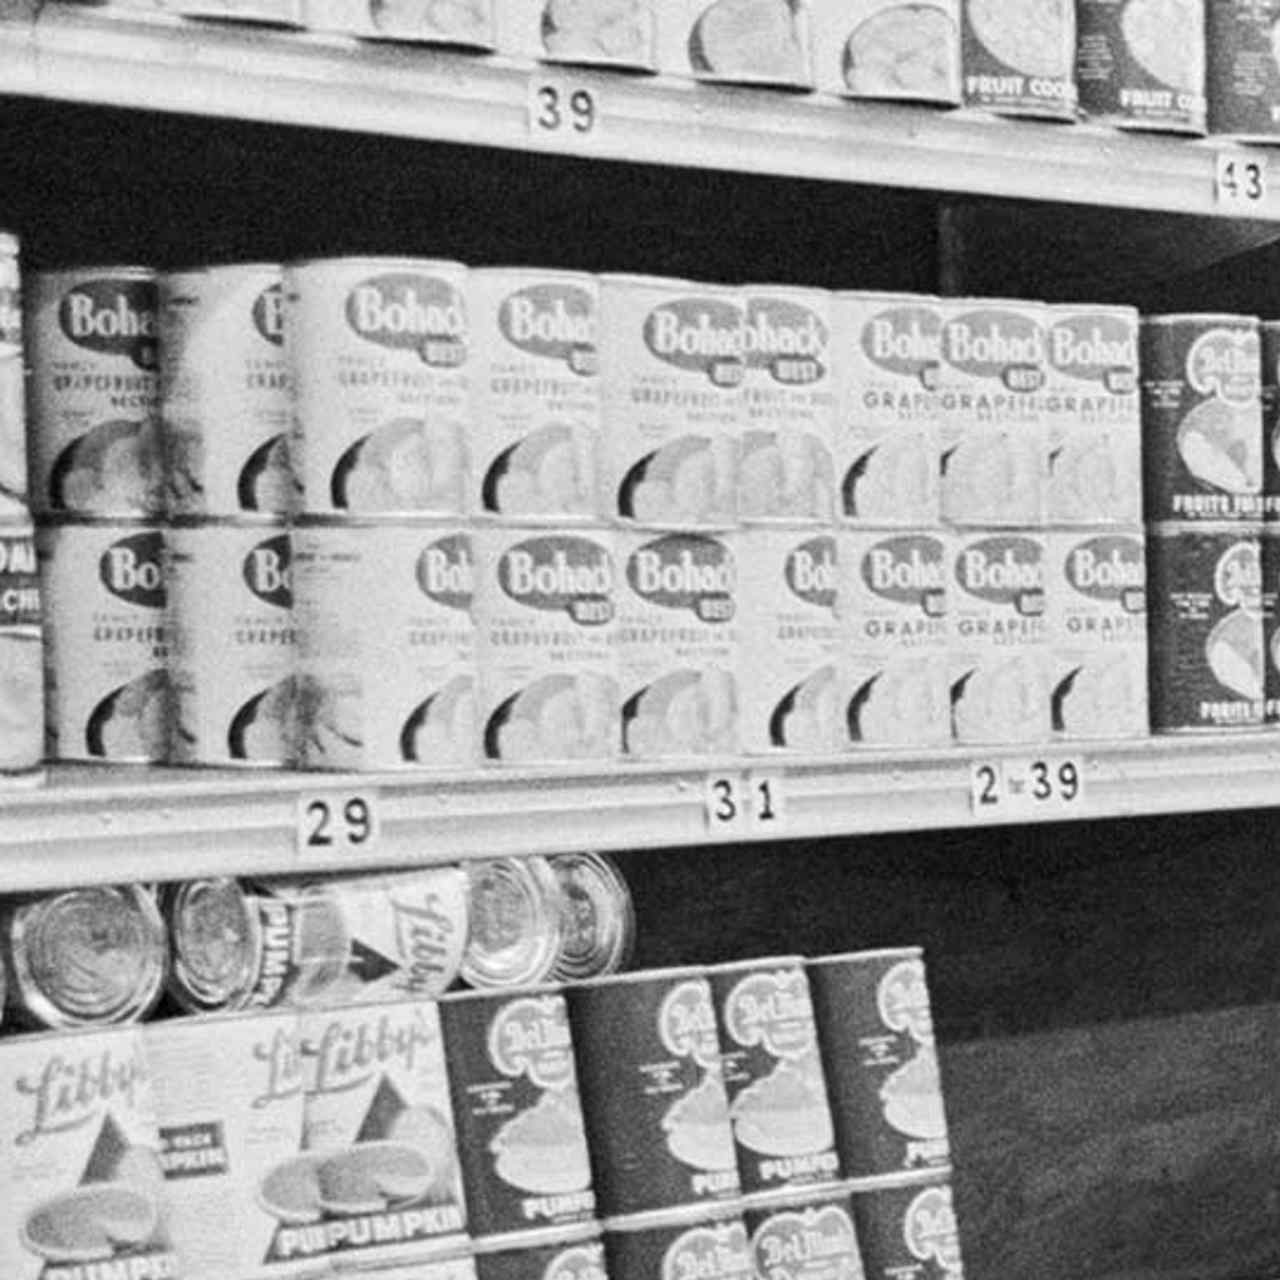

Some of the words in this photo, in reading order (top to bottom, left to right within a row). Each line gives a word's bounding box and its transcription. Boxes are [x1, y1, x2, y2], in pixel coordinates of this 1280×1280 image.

[967, 75, 1024, 97] FRUIT
[1120, 89, 1172, 109] FRUIT
[538, 87, 595, 133] 39
[713, 779, 775, 822] 31
[1031, 761, 1079, 801] 39
[307, 801, 371, 845] 29
